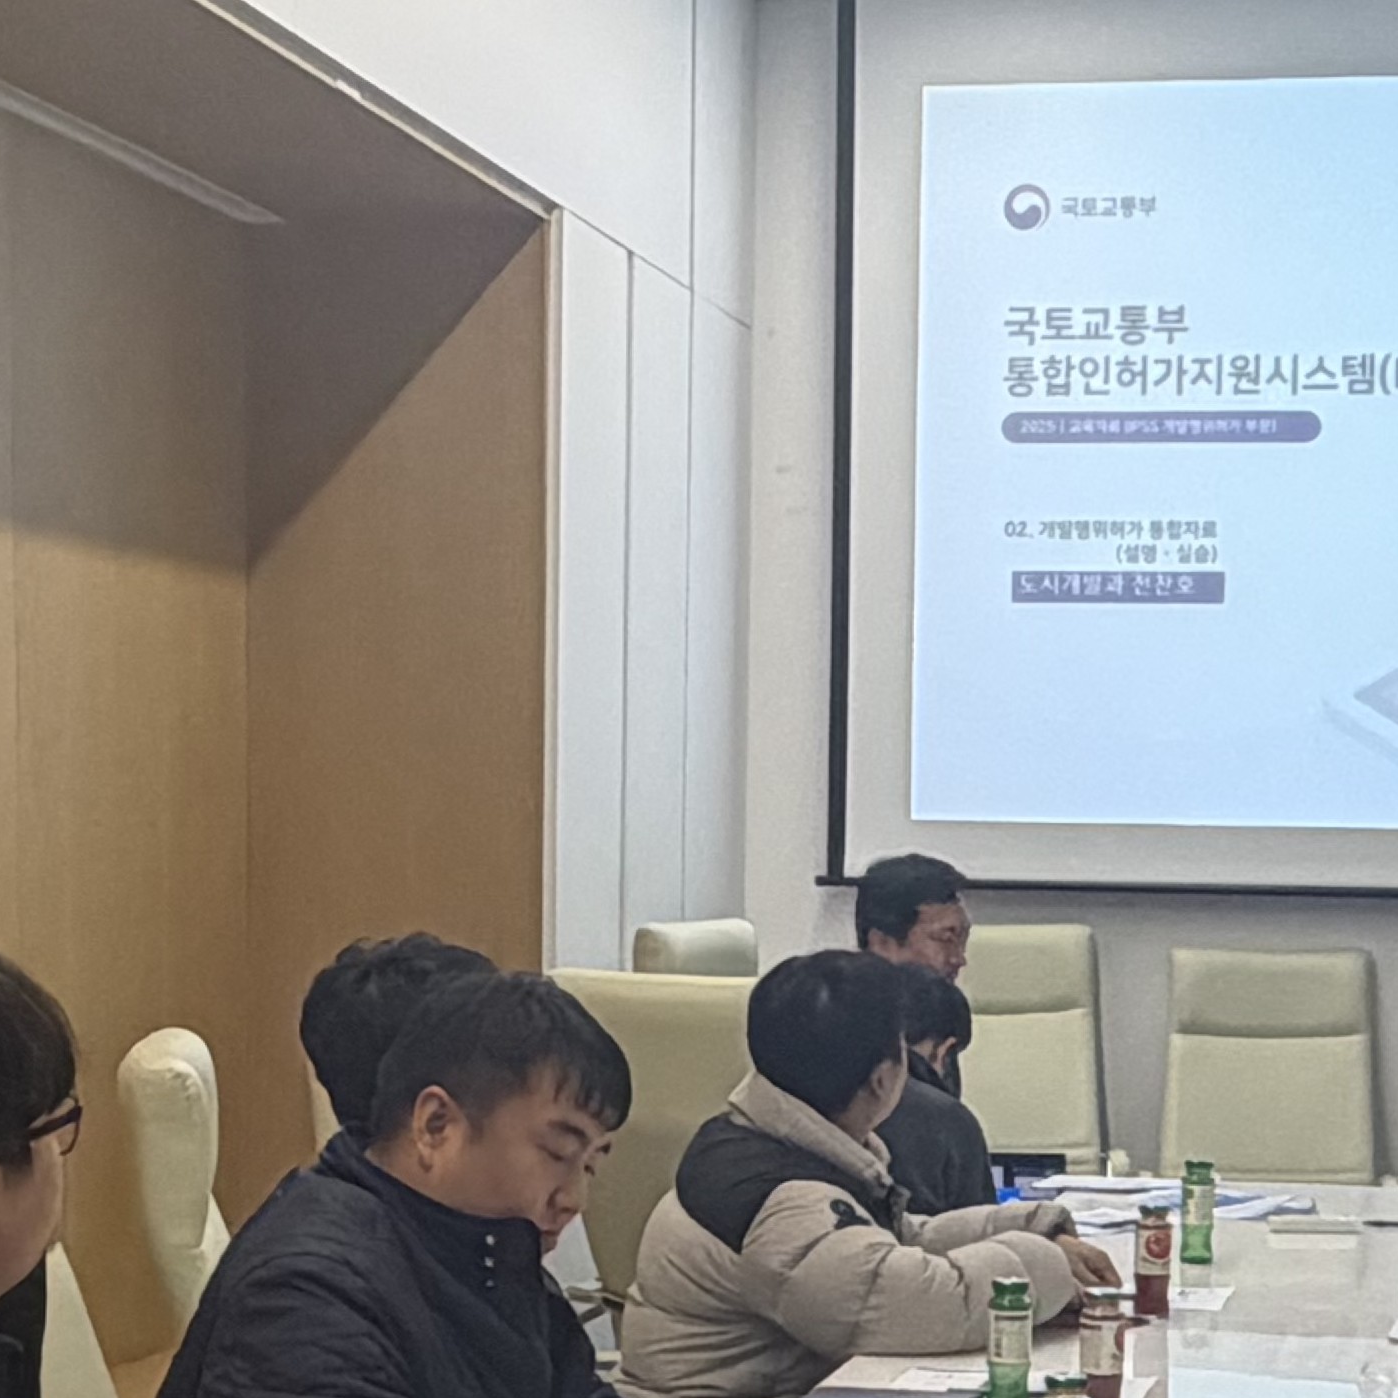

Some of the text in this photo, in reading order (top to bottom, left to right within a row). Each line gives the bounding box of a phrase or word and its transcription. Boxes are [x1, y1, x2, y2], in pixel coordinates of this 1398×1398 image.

[1061, 196, 1157, 218] 국토교통부
[1003, 304, 1190, 346] 국토교통부
[1004, 521, 1034, 538] 02.
